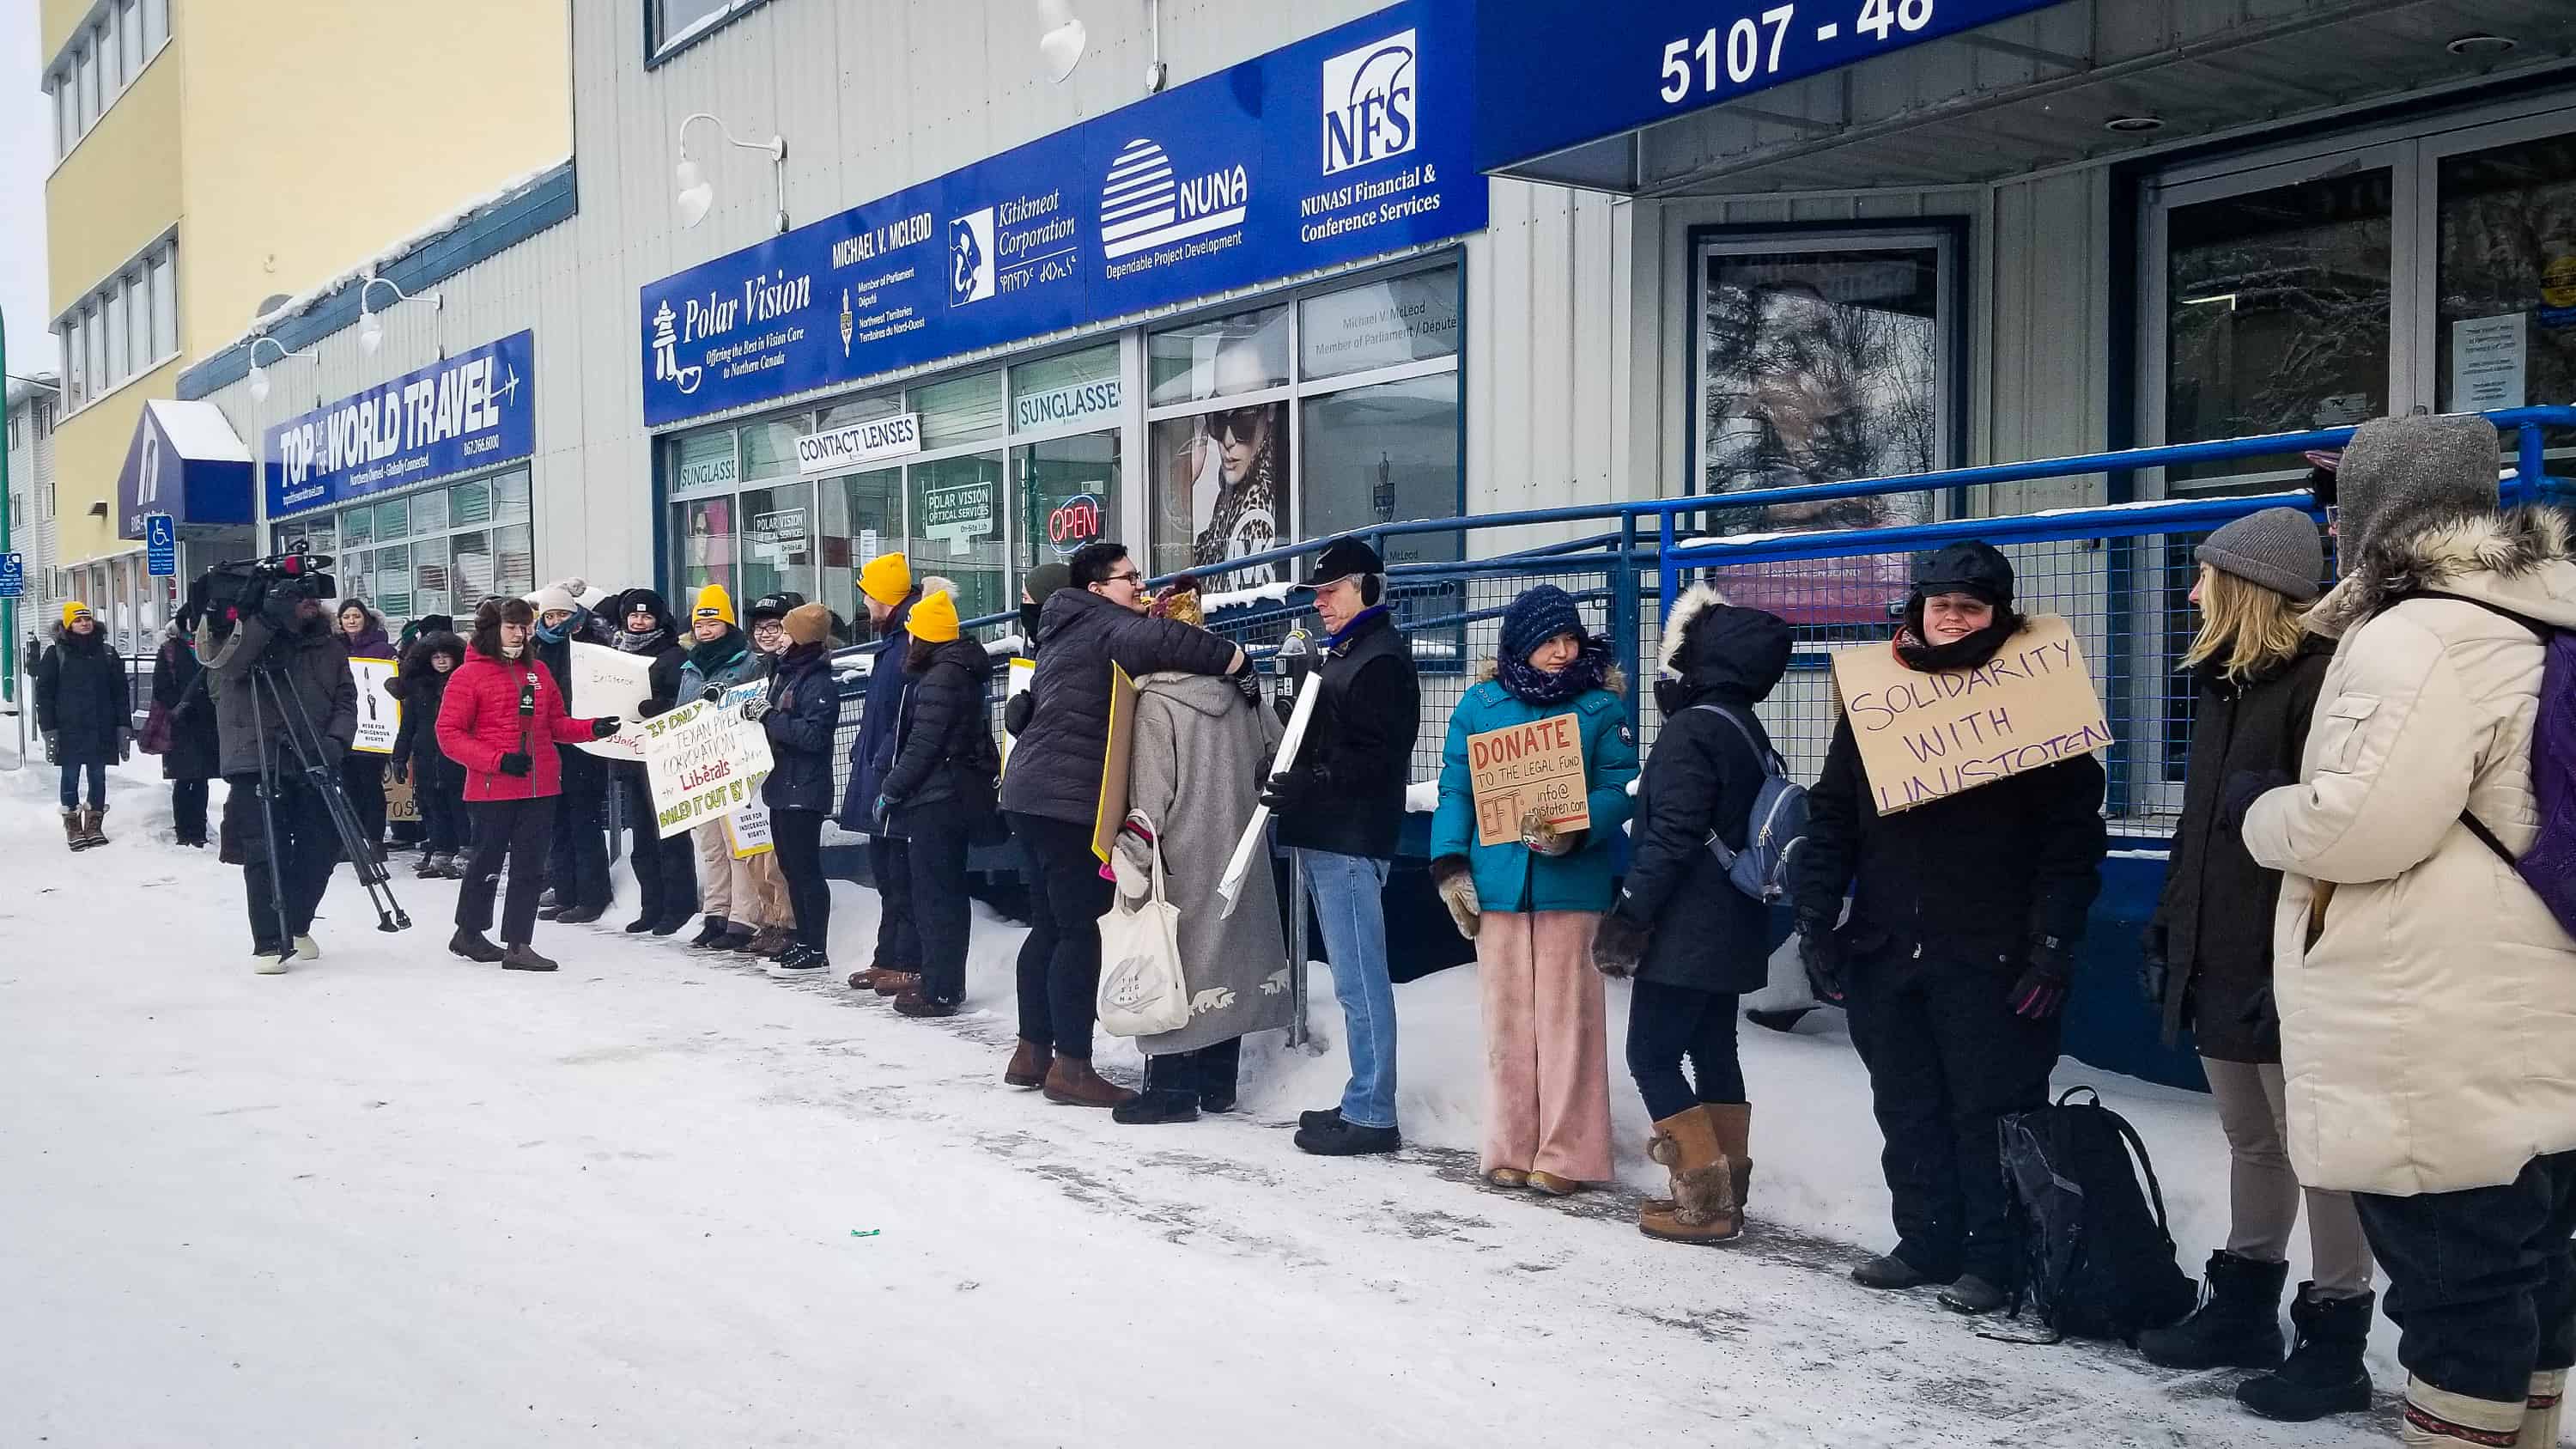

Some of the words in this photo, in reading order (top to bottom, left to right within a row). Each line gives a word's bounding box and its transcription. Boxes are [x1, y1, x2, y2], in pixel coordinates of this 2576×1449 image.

[1661, 3, 1794, 103] 5107
[1326, 87, 1411, 172] NFS
[998, 187, 1060, 228] Kitikmeot
[1180, 164, 1248, 220] NUNA
[1301, 186, 1352, 218] NUNASI
[1355, 167, 1420, 204] Financial
[1423, 164, 1437, 184] &
[1301, 213, 1377, 243] Conference
[1380, 193, 1441, 223] Services
[832, 232, 876, 270] MICHAEL
[877, 227, 887, 255] V.
[889, 212, 933, 251] MCLEOD
[999, 216, 1075, 258] Corporation
[1106, 254, 1152, 280] Dependable
[1154, 246, 1184, 267] Project
[1185, 229, 1242, 259] Development
[858, 279, 880, 294] Member
[880, 276, 886, 287] of
[886, 267, 914, 285] Parliament
[683, 290, 738, 344] Polar
[744, 269, 811, 326] Vision
[858, 293, 878, 307] Député
[859, 312, 885, 329] Northwest
[886, 306, 913, 321] Territories
[1342, 314, 1377, 330] Michael
[1389, 301, 1425, 320] McLeod
[706, 346, 732, 367] Offering
[732, 343, 743, 356] the
[744, 339, 757, 355] Best
[757, 336, 764, 350] in
[766, 332, 786, 349] Vision
[787, 326, 805, 343] Care
[860, 327, 885, 344] Territoires
[894, 317, 926, 335] Nord-Ouest
[1315, 340, 1352, 356] Member
[1353, 337, 1363, 348] of
[1365, 326, 1413, 345] Parliament
[1422, 314, 1457, 334] Député
[723, 368, 730, 379] to
[731, 360, 759, 378] Northern
[760, 350, 786, 370] Canada
[280, 423, 315, 488] TOP
[326, 391, 401, 472] WORLD
[404, 356, 500, 451] TRAVEL
[315, 419, 324, 447] OF
[799, 433, 861, 462] CONTACT
[860, 418, 914, 449] LENSES
[315, 450, 327, 478] THE
[404, 452, 429, 472] Connected
[928, 494, 957, 509] POLAR
[957, 487, 988, 505] VISION
[928, 508, 957, 523] OPTICAL
[957, 504, 989, 519] SERVICES
[756, 517, 778, 531] POLAR
[779, 513, 803, 528] VISION
[780, 527, 804, 539] SERVICES
[1049, 505, 1098, 542] OPEN
[1389, 550, 1418, 561] McLeod
[1851, 638, 2070, 731] SOLIDARITY
[645, 721, 664, 739] IF
[669, 703, 704, 730] ONLY
[673, 724, 713, 750] TEXAN
[1903, 707, 2014, 764] WITH
[663, 732, 737, 776] CORPORATION
[1473, 719, 1571, 770] DONATE
[680, 759, 731, 791] Liberals
[1476, 771, 1494, 788] TO
[1498, 764, 1520, 780] THE
[1524, 759, 1554, 776] LEGAL
[1558, 755, 1580, 770] FUND
[1880, 720, 2111, 810] UNISTOTEN
[659, 796, 693, 829] BAILED
[692, 795, 704, 816] IT
[704, 785, 727, 811] OUT
[728, 778, 743, 801] BY
[1537, 783, 1570, 802] info@
[738, 819, 769, 831] INDIGENOUS
[747, 829, 766, 839] RIGHTS
